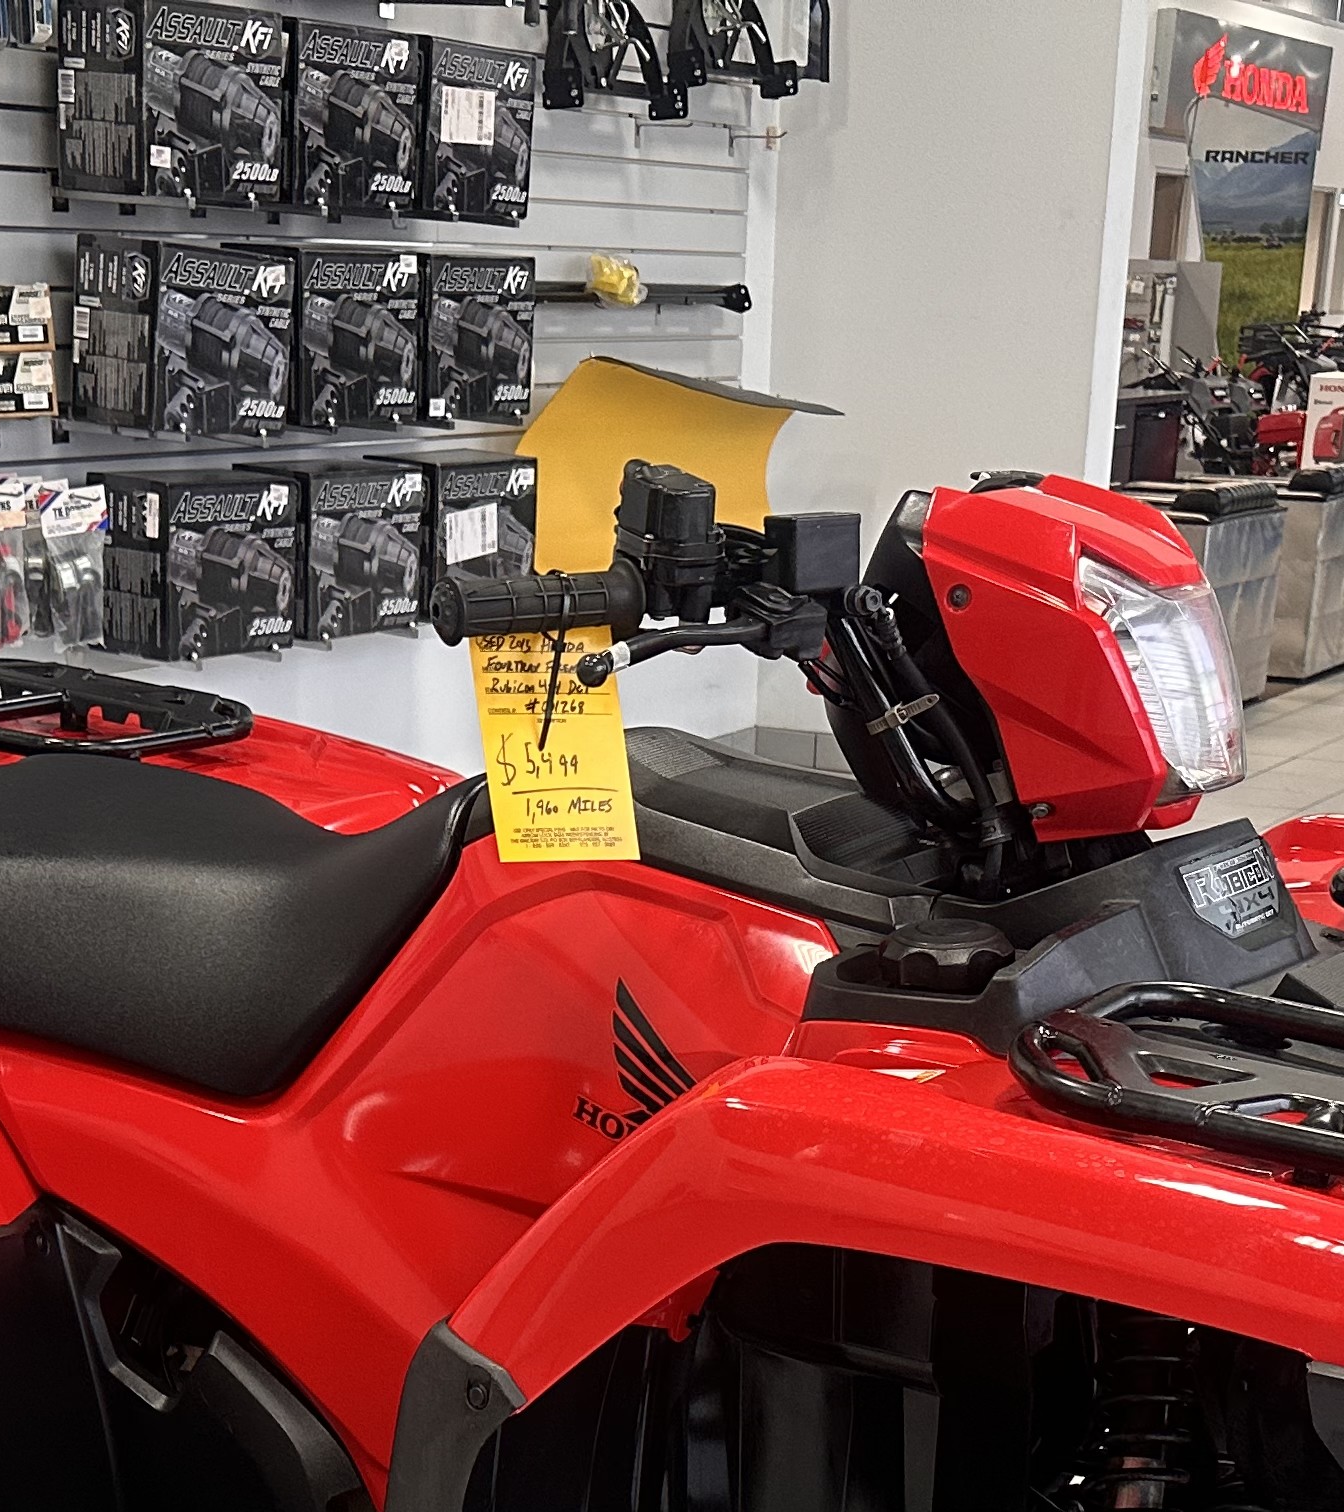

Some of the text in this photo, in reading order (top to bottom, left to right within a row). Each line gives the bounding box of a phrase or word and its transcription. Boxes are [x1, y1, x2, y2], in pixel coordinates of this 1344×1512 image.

[146, 6, 242, 47] ASSAULT
[299, 29, 383, 68] ASSAULT
[433, 47, 506, 84] ASSAULT
[1222, 60, 1309, 114] HONDA
[1204, 150, 1310, 165] RANCHER
[161, 252, 254, 292] ASSAULT
[304, 257, 385, 291] ASSAULT
[433, 262, 506, 293] ASSAULT
[313, 481, 389, 511] ASSAULT
[443, 472, 509, 499] ASSAULT
[170, 492, 259, 523] ASSAULT
[526, 796, 613, 824] 1,960 MILES
